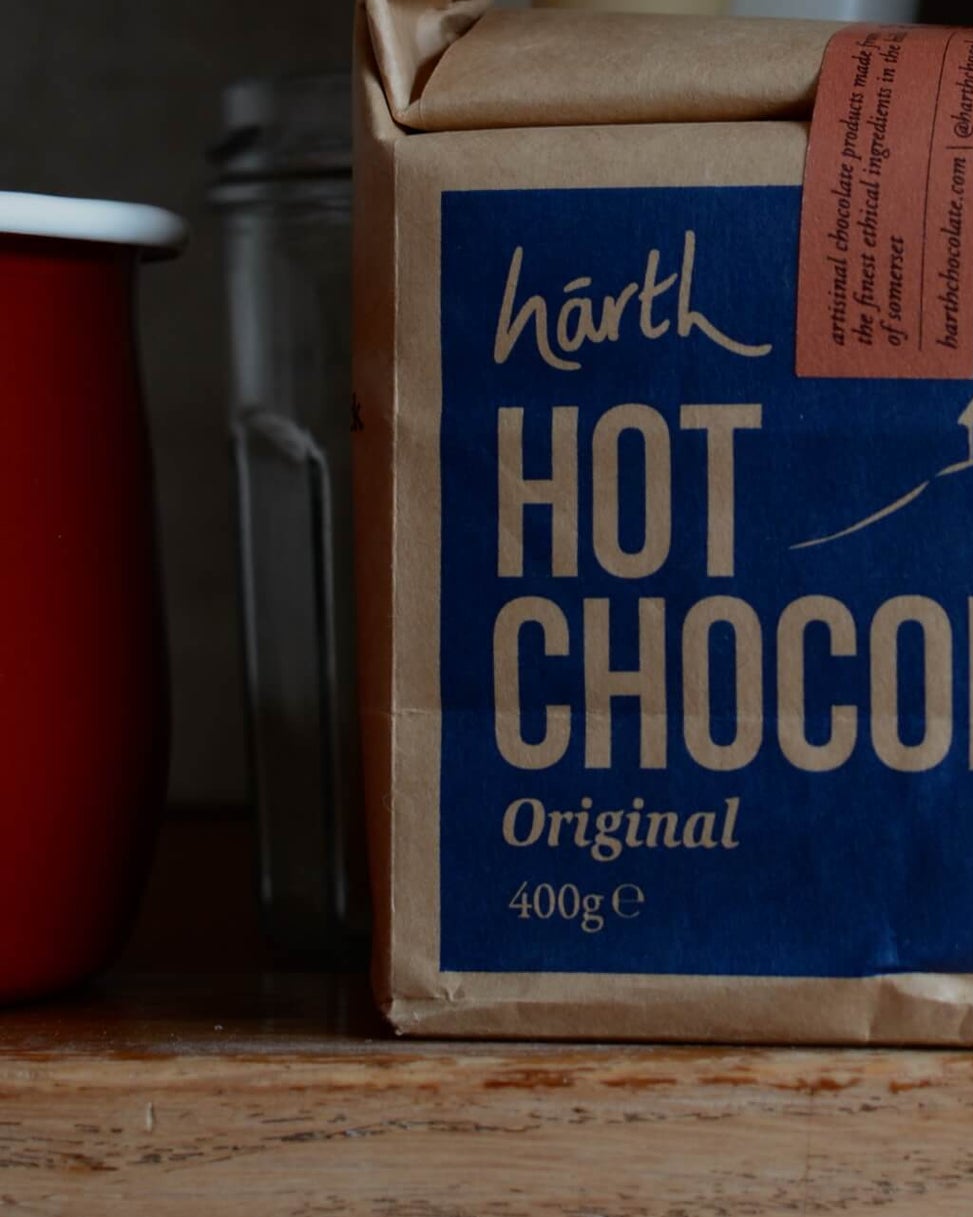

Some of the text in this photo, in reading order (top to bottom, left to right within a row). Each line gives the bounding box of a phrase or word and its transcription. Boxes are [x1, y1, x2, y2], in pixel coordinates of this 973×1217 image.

[850, 51, 872, 88] made
[874, 68, 893, 83] in
[879, 45, 900, 63] the
[841, 92, 864, 158] products
[863, 88, 891, 175] ingredients
[829, 164, 853, 251] chocolate
[859, 181, 880, 247] ethical
[853, 254, 880, 308] finest
[936, 157, 966, 349] harthchocolate.com
[828, 257, 848, 346] artisinal
[881, 235, 907, 346] of somerset
[853, 314, 874, 345] the
[497, 404, 762, 579] HOT
[502, 796, 741, 862] Original
[508, 881, 605, 933] 400g
